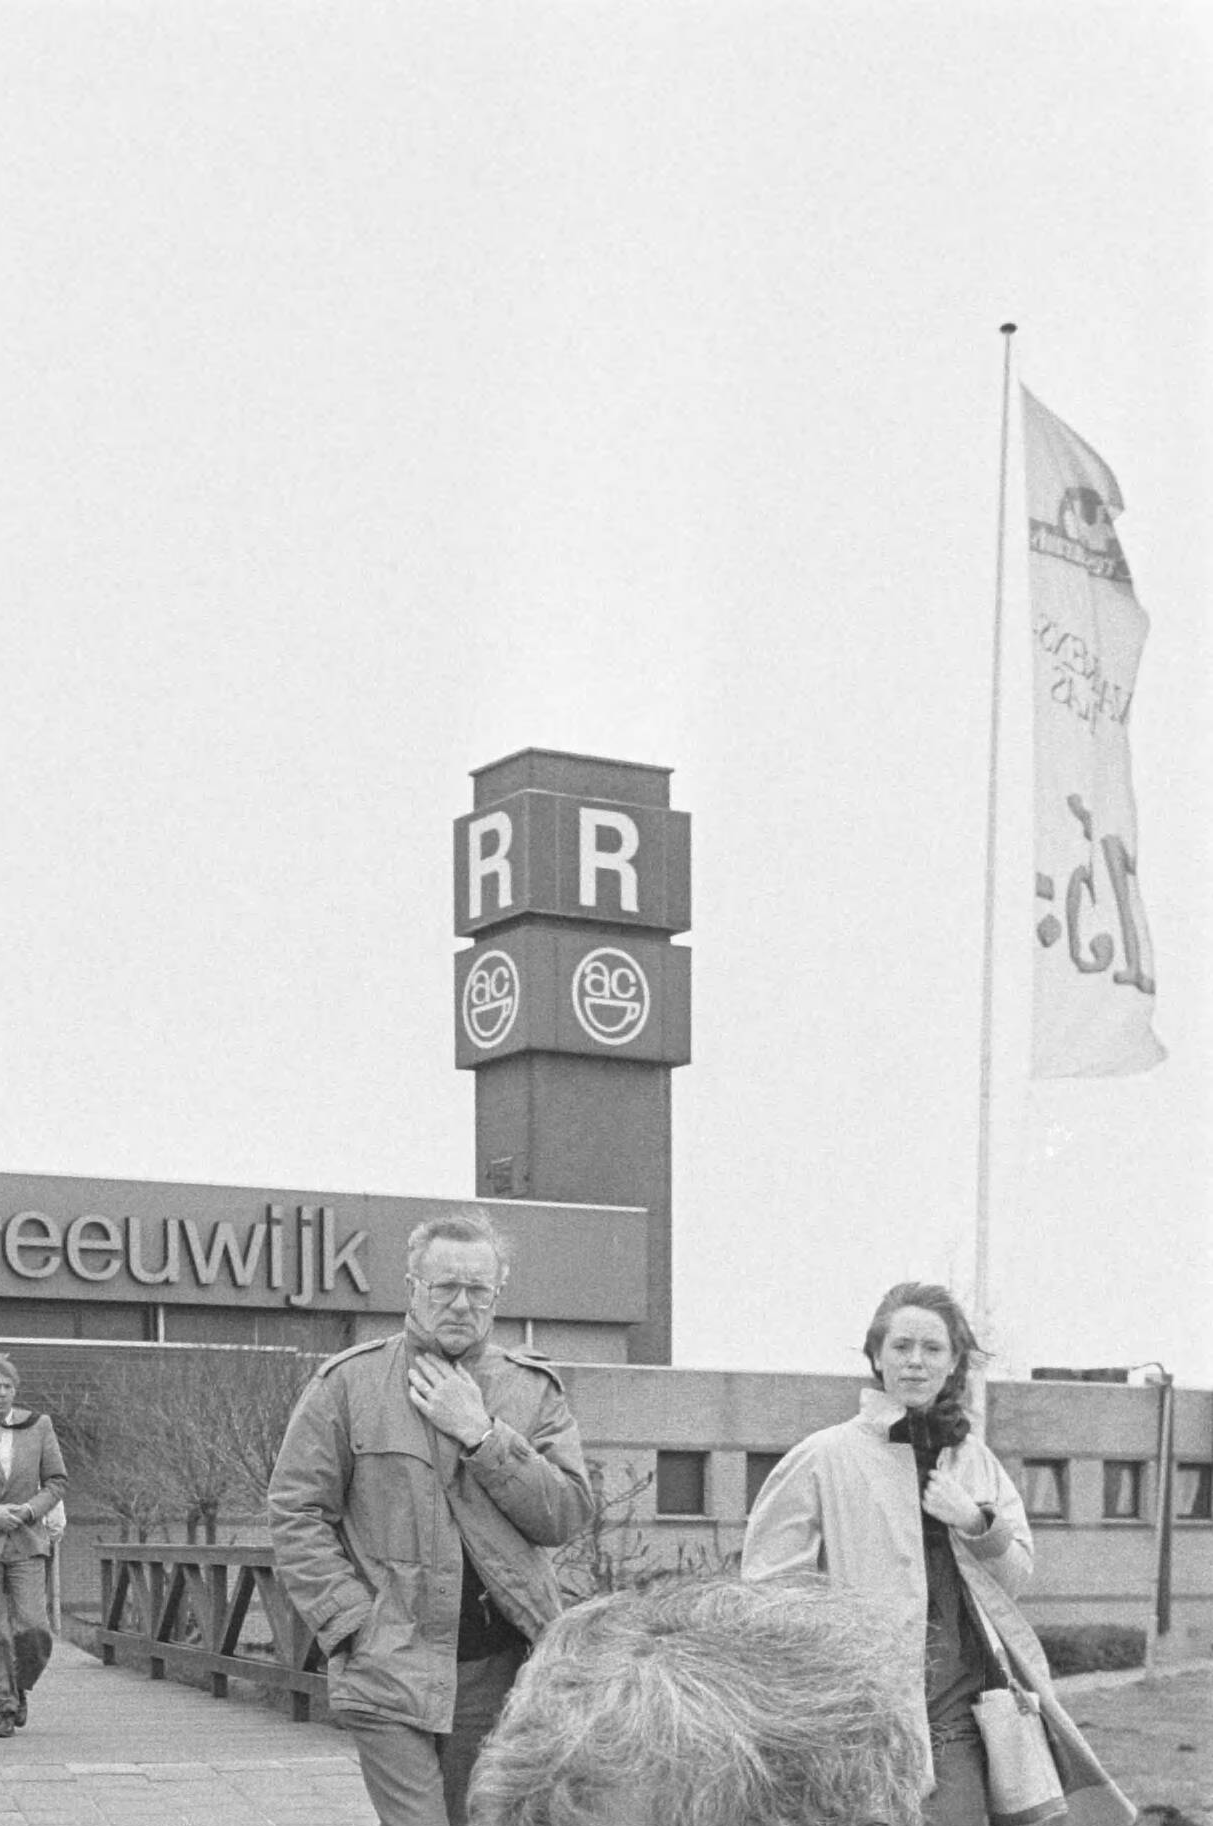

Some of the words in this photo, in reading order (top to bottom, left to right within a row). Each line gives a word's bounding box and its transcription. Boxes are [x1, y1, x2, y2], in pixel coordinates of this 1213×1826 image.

[468, 810, 513, 919] R
[578, 806, 640, 913] R
[471, 966, 510, 1005] ac
[584, 961, 637, 999] ac
